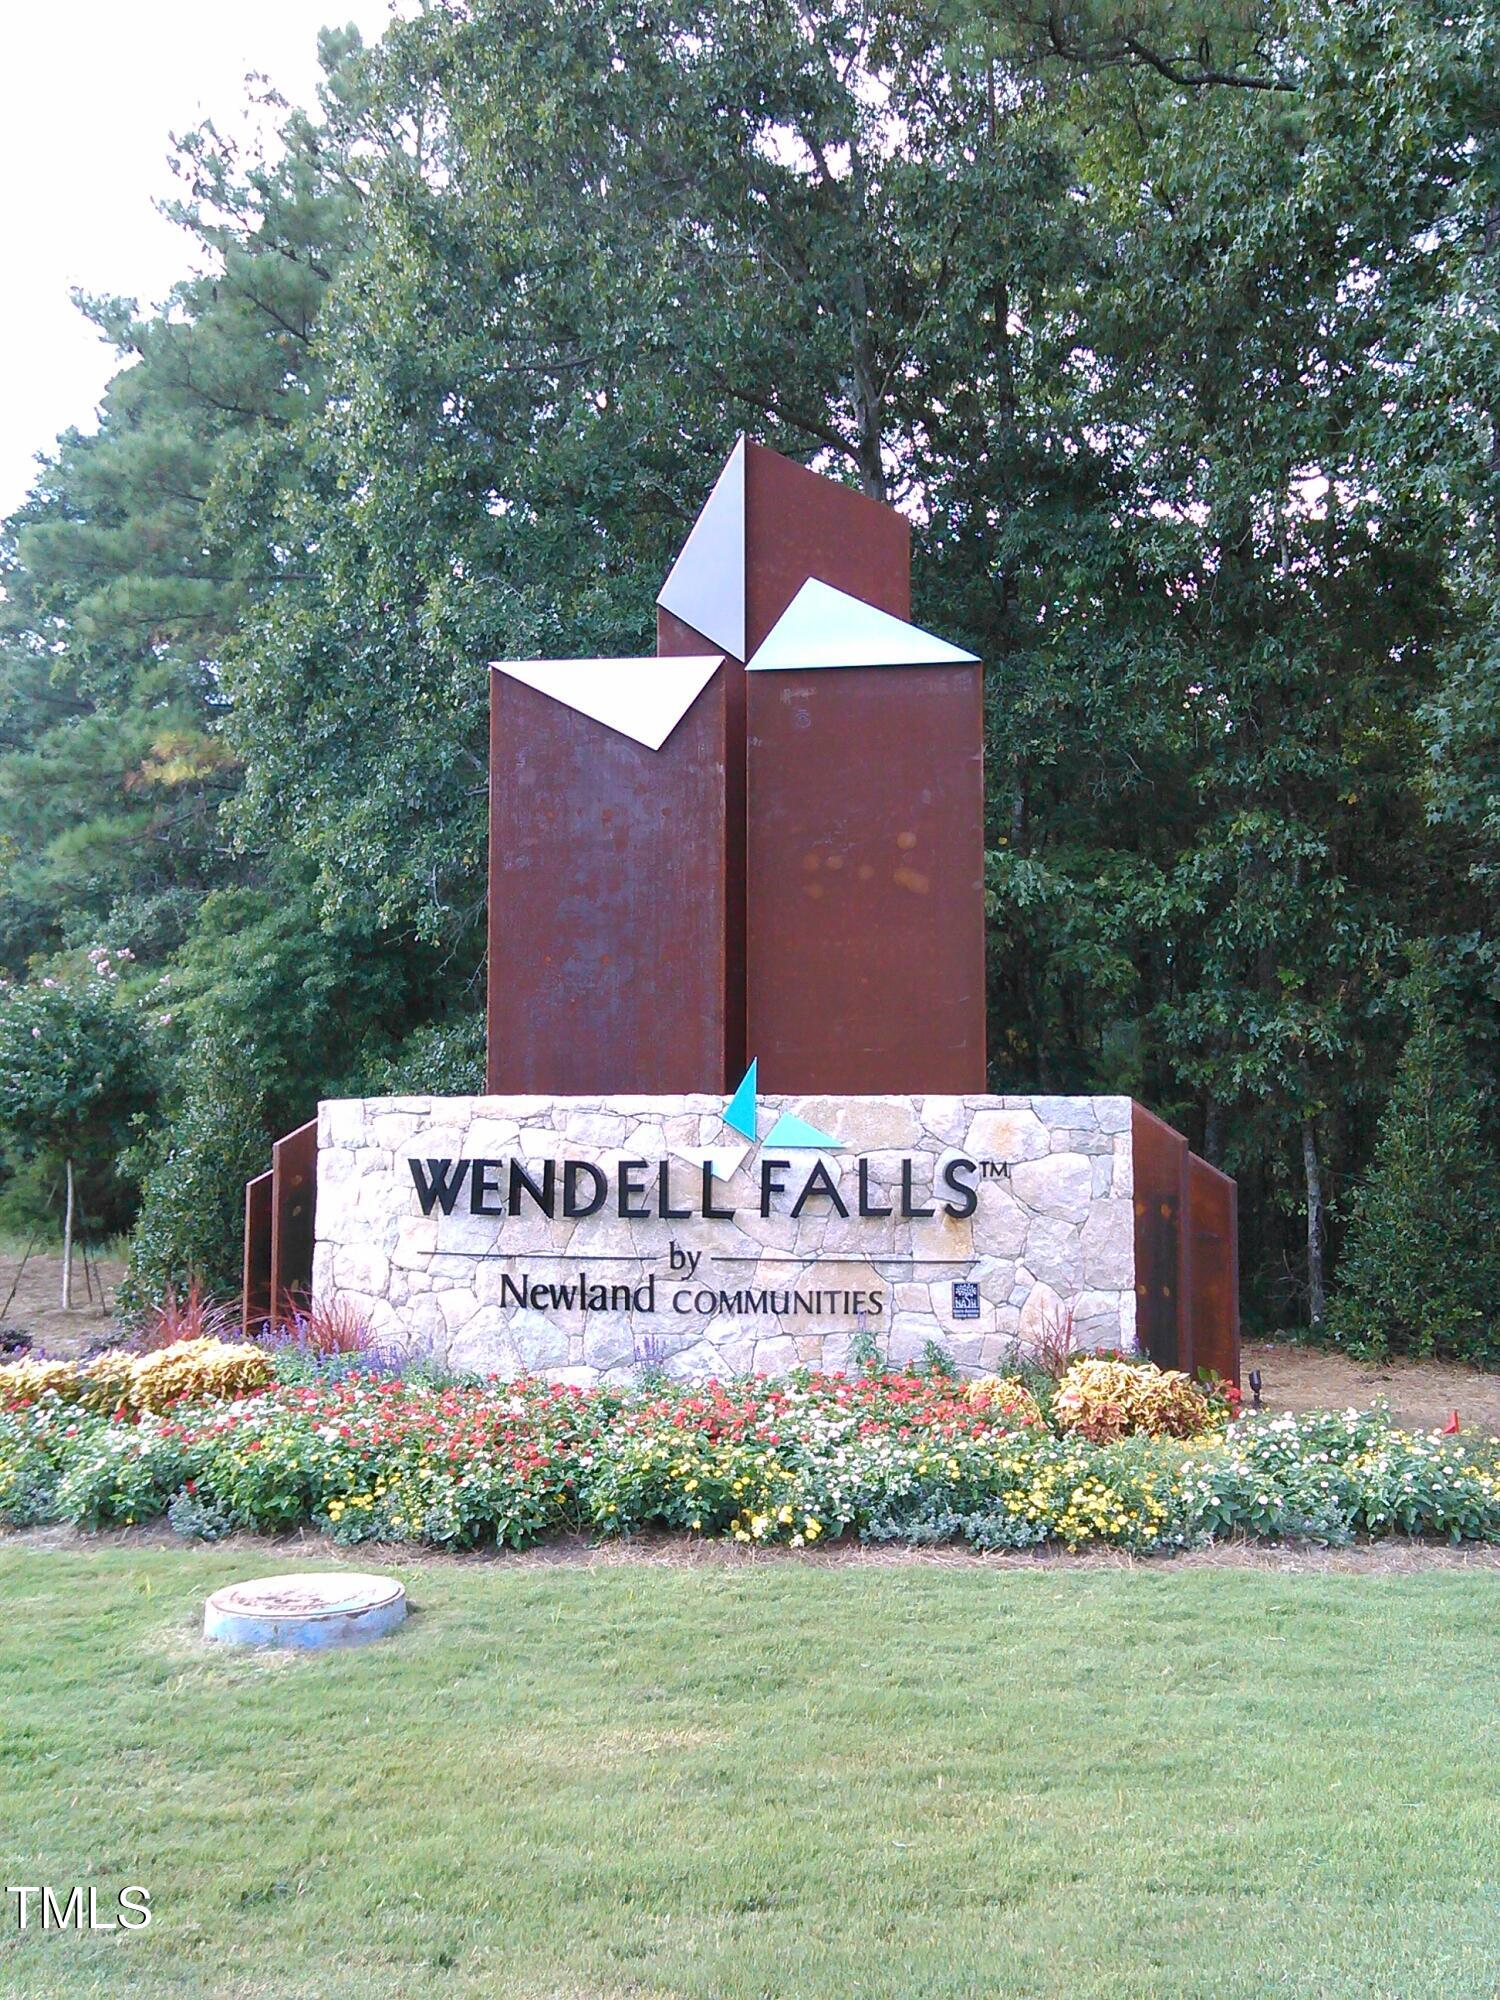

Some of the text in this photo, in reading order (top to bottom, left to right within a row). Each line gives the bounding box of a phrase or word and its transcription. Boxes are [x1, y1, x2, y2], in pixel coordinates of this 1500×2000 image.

[407, 1157, 736, 1219] WENDELL
[669, 1240, 703, 1281] by
[499, 1272, 884, 1316] Newland COMMUNITIES
